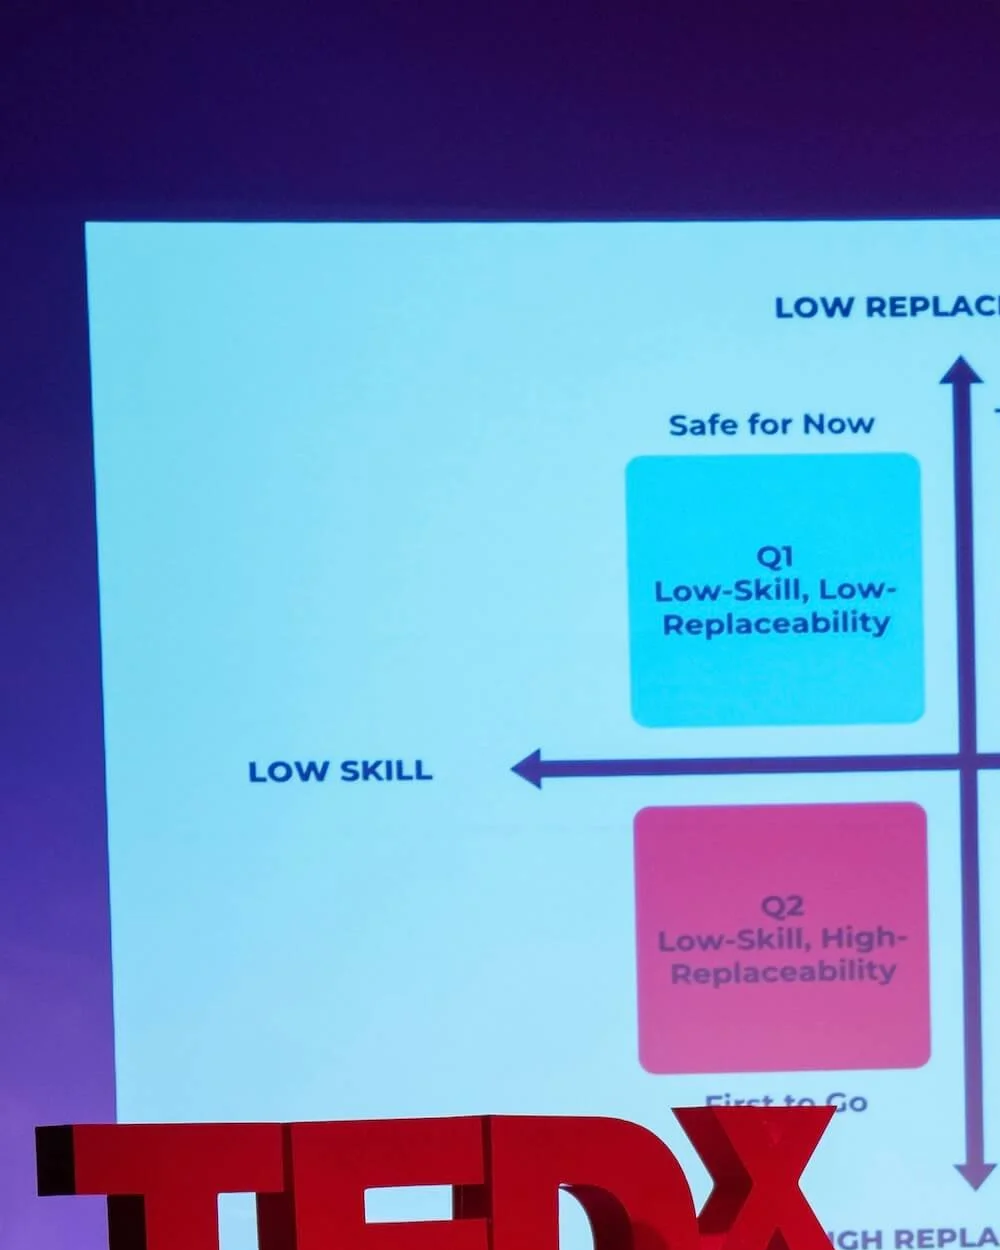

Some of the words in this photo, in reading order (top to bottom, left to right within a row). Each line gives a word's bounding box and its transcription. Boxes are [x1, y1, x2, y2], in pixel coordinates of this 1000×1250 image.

[776, 296, 855, 319] LOW
[669, 413, 739, 437] Safe
[748, 412, 793, 436] for
[803, 412, 875, 435] Now
[756, 545, 793, 572] Q1
[655, 577, 810, 604] Low-Skill,
[819, 578, 897, 600] Low-
[663, 609, 891, 641] Replaceability
[248, 760, 330, 783] LOW
[340, 759, 434, 782] SKILL
[761, 894, 805, 922] Q2
[658, 926, 812, 953] Low-Skill,
[821, 924, 908, 954] High-
[671, 957, 897, 989] Replaceability
[826, 1092, 868, 1113] Go
[827, 1230, 882, 1250] IGH
